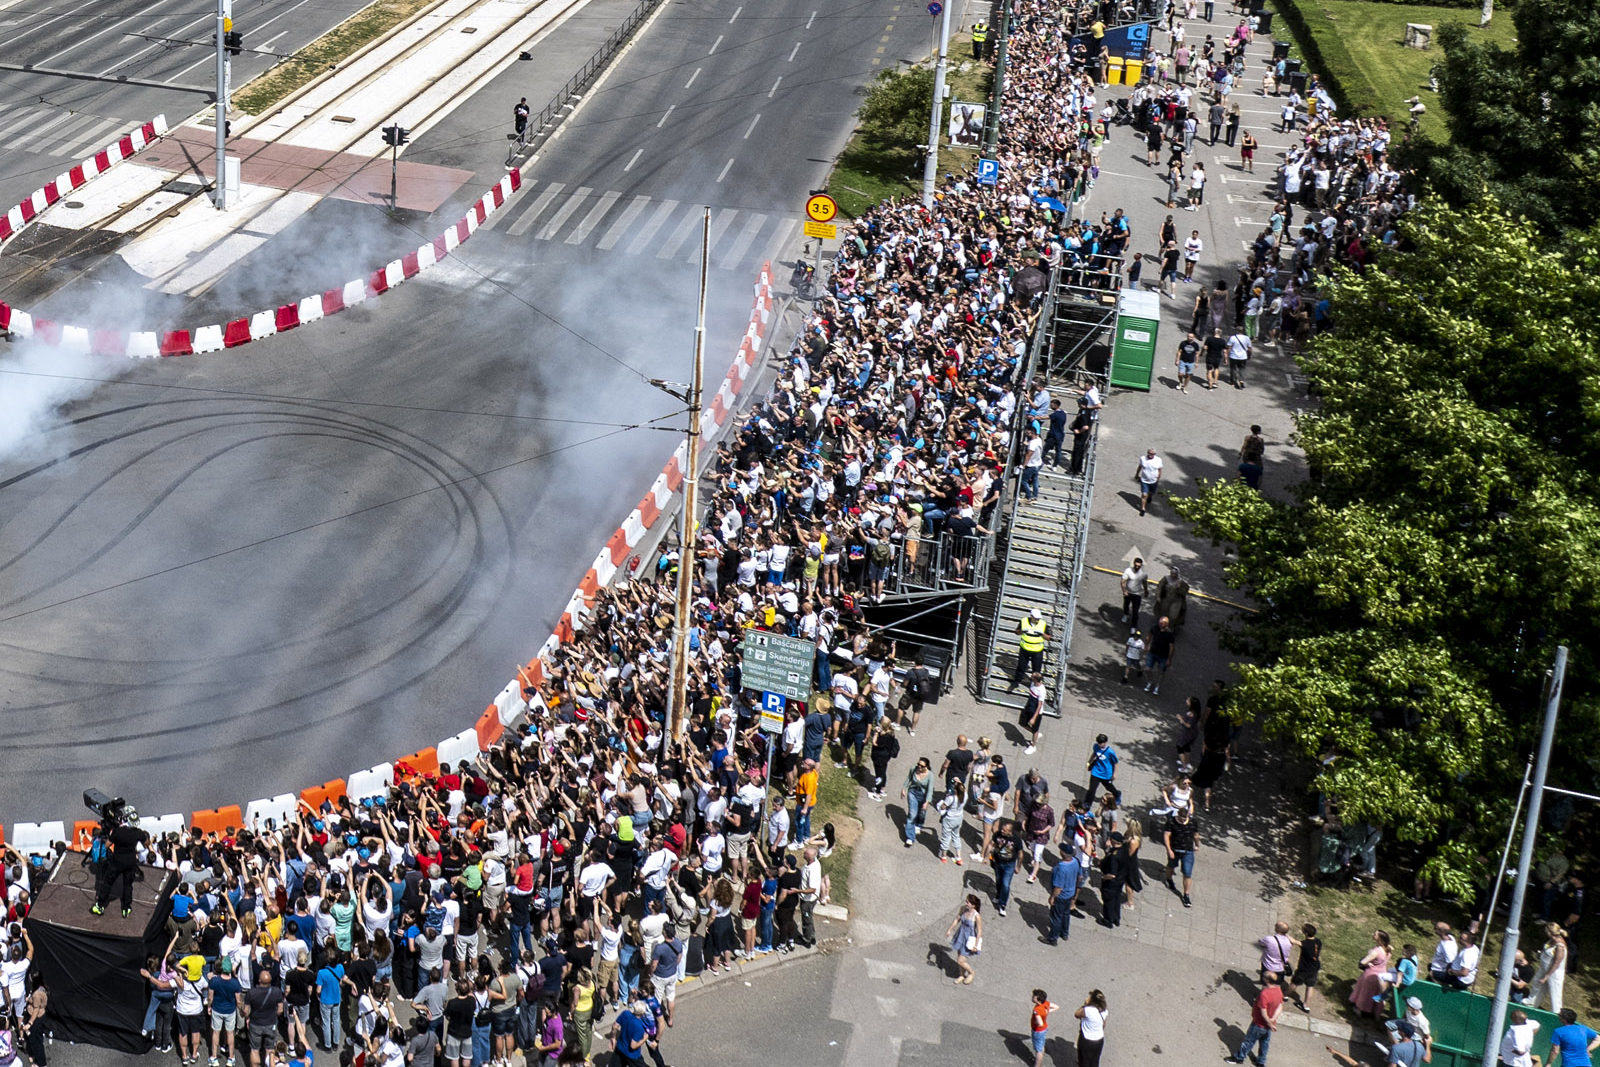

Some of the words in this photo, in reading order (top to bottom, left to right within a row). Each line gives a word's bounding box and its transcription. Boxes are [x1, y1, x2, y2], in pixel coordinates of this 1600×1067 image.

[1133, 28, 1142, 38] C
[983, 162, 994, 175] P
[772, 638, 811, 652] Baščaršija
[769, 652, 810, 667] Skenderija
[767, 694, 780, 709] P
